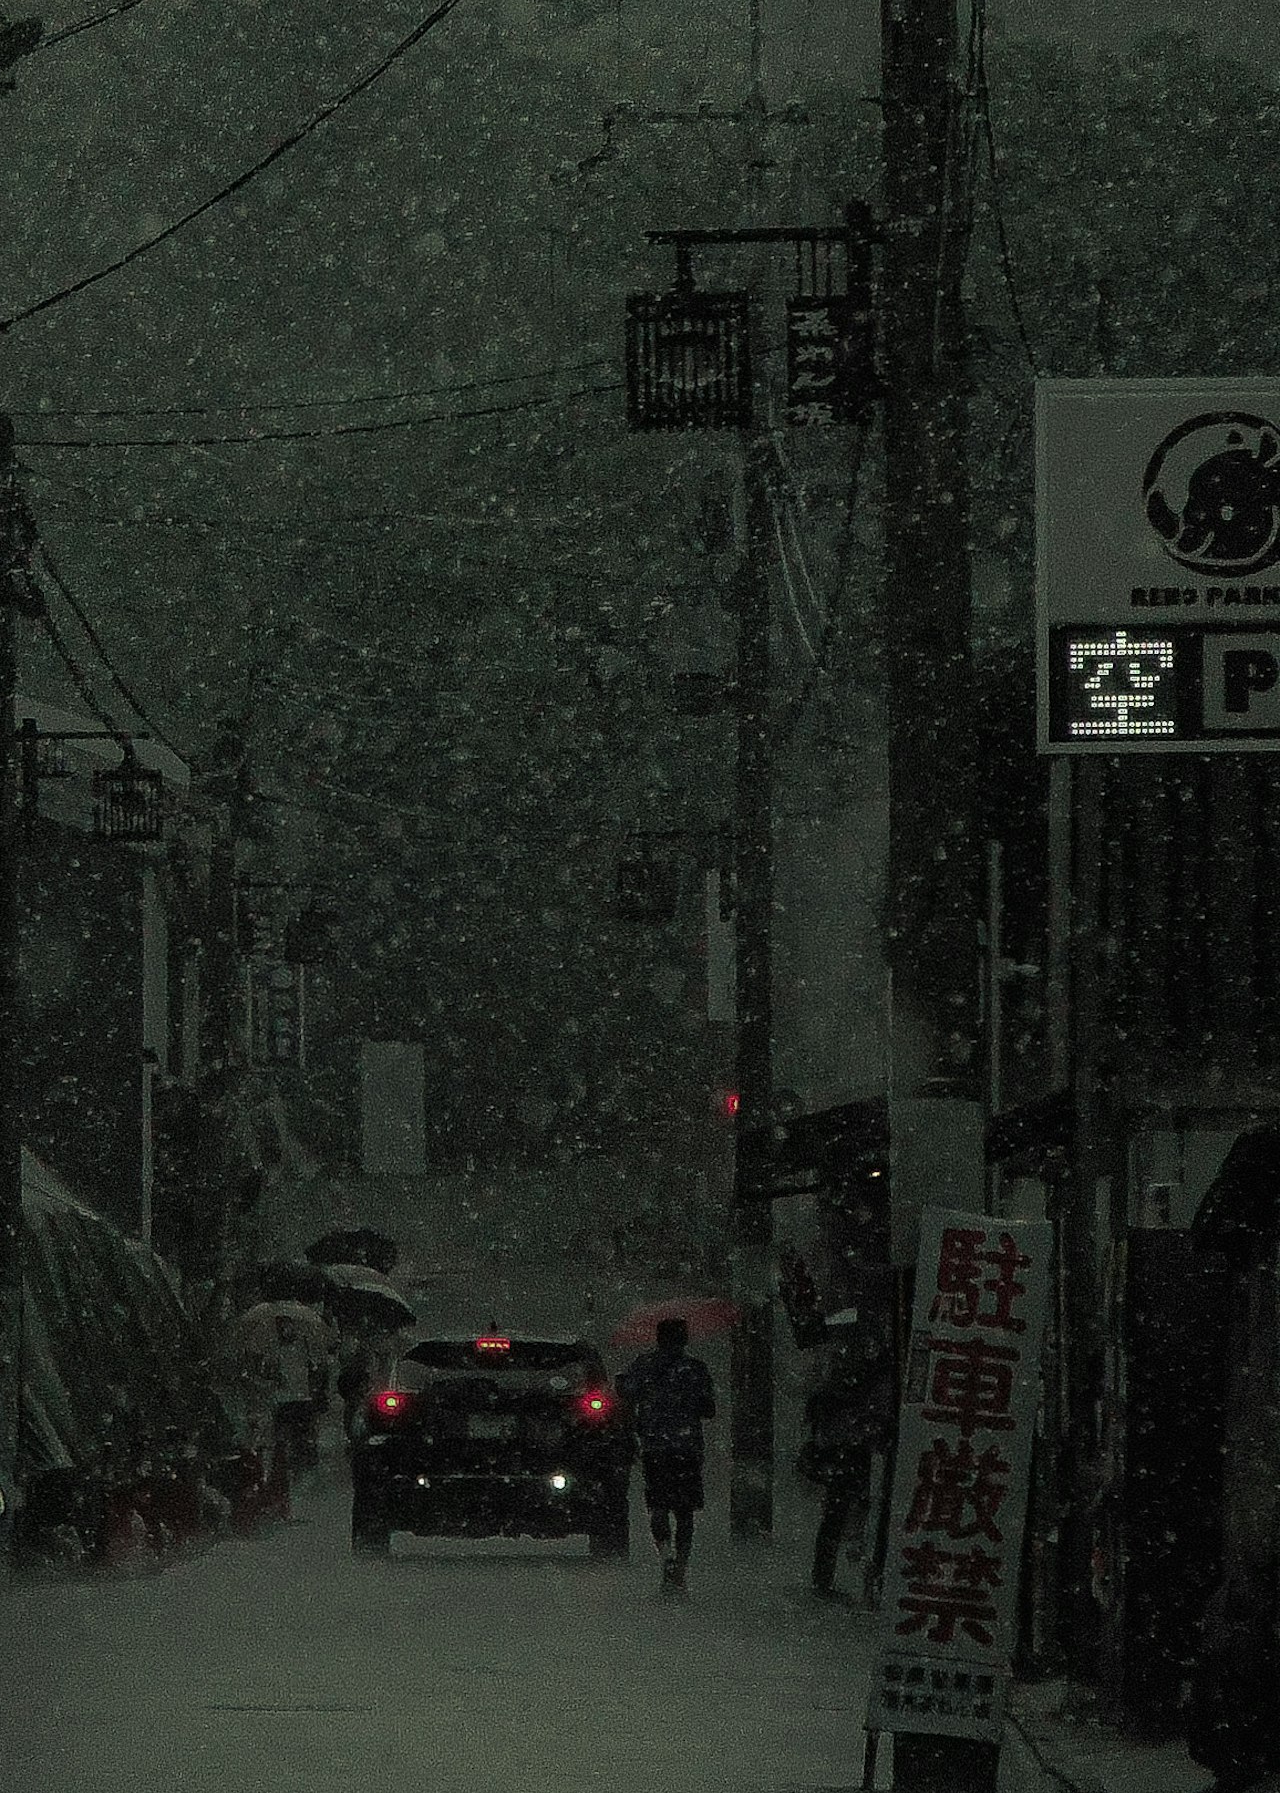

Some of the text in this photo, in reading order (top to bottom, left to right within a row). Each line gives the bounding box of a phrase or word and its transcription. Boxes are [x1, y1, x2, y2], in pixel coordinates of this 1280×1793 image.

[1069, 630, 1175, 735] 空
[1223, 650, 1278, 713] P
[895, 1227, 1032, 1646] 駐車厳禁
